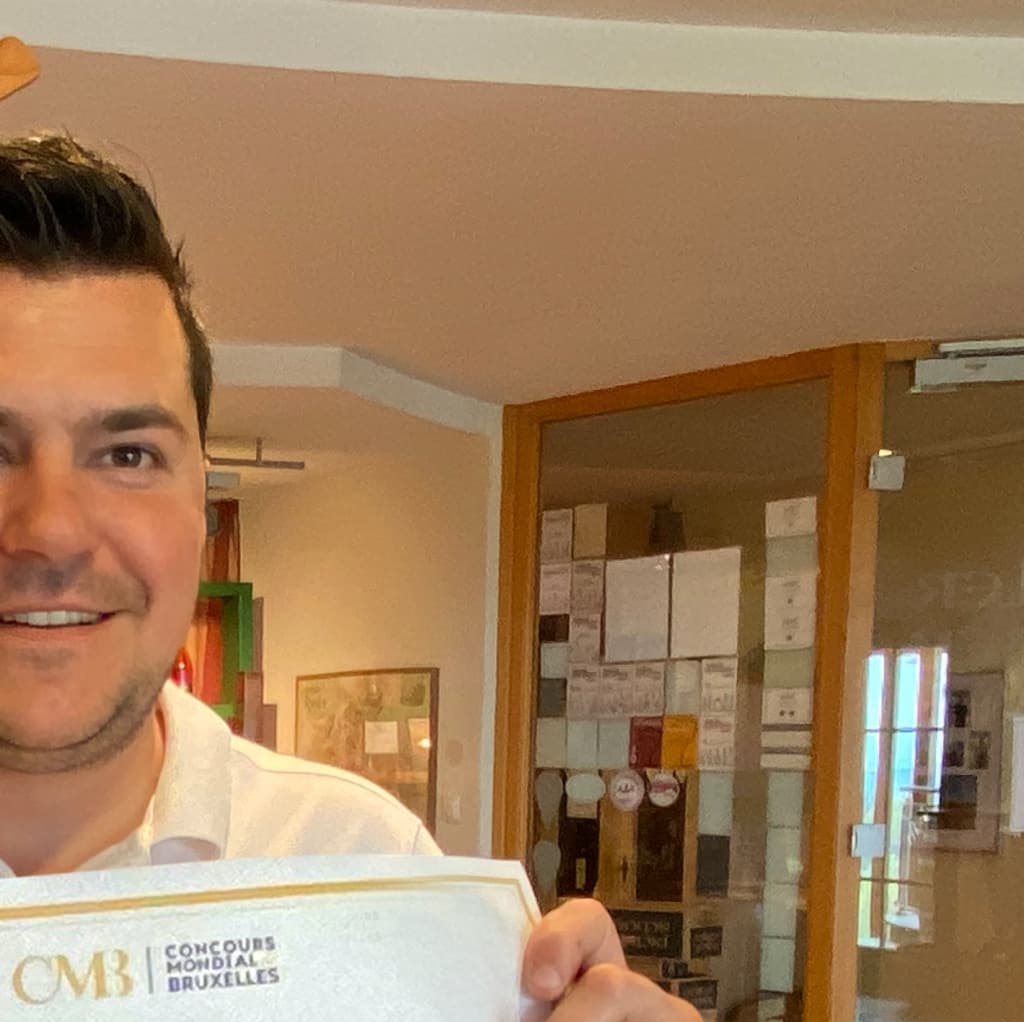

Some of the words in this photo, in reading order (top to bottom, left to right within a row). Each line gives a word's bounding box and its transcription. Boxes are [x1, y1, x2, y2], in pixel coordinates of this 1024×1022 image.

[165, 936, 276, 959] CONCOURS
[167, 954, 258, 973] MONDIAL
[168, 967, 280, 992] BRUXELLES
